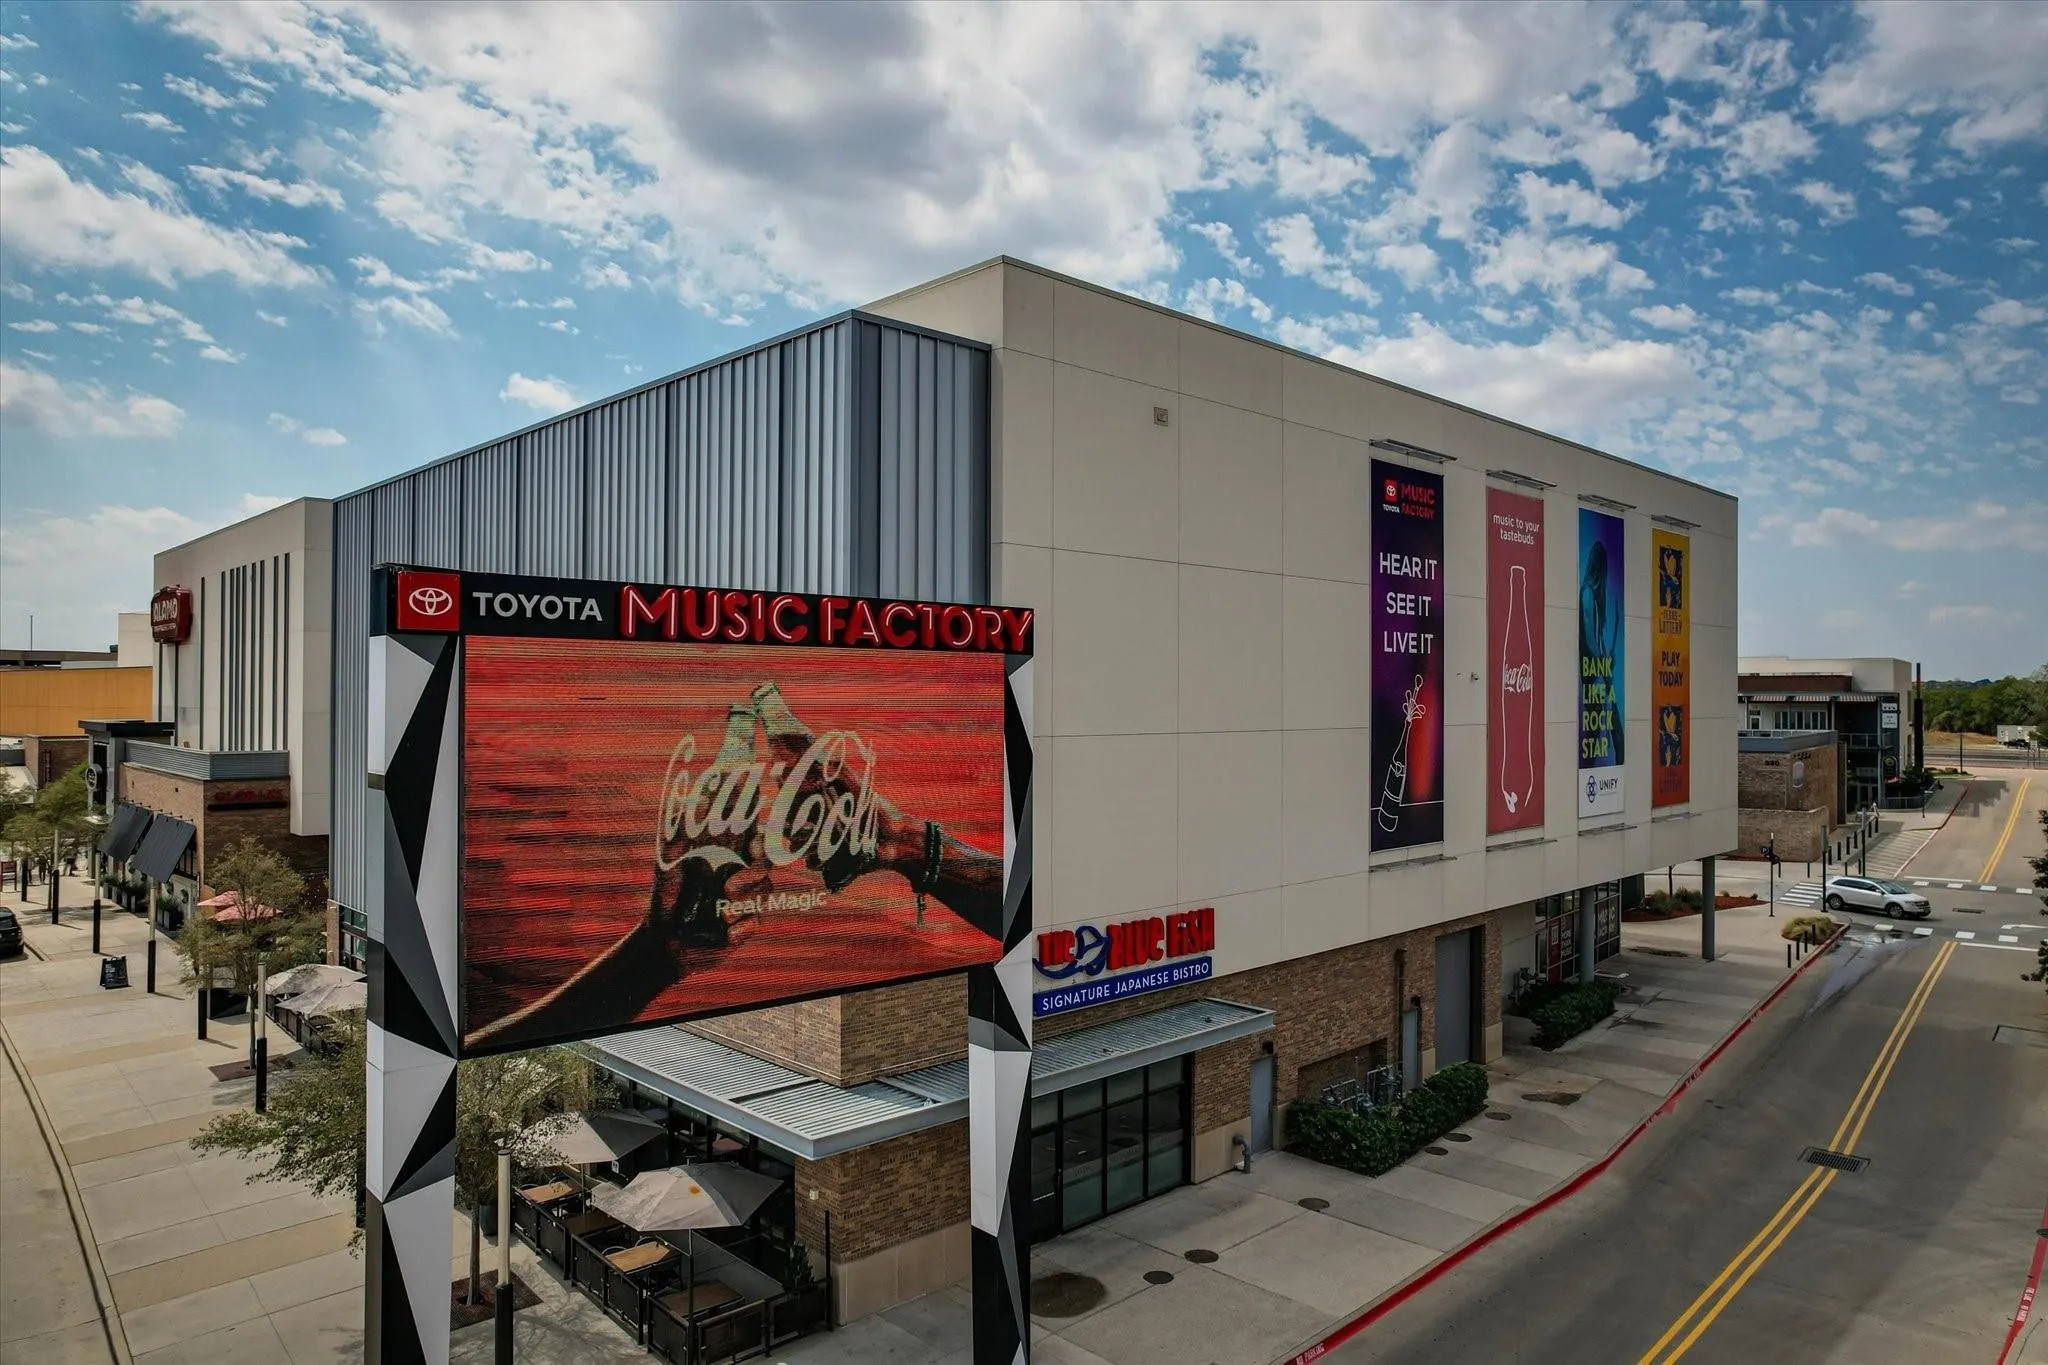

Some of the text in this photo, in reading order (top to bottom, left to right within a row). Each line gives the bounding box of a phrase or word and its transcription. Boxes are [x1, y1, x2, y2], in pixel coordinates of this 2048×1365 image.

[1401, 483, 1436, 505] MUSIC
[1382, 503, 1400, 513] TOYOTA
[1402, 502, 1435, 520] FACTORY
[1493, 514, 1540, 533] music to your
[1500, 528, 1534, 545] tastebuds
[1379, 552, 1438, 580] HEAR IT
[1386, 591, 1432, 617] SEE IT
[472, 584, 1033, 651] TOYOTA MUSIC FACTORY
[1384, 631, 1434, 655] LIVE IT
[1582, 656, 1613, 678] BANK
[1661, 650, 1680, 667] PLAY
[1658, 671, 1684, 688] TODAY
[1582, 683, 1616, 704] LIKE A
[1582, 710, 1614, 732] ROCK
[1581, 736, 1609, 759] STAR
[1599, 777, 1619, 791] UNIFY
[715, 889, 828, 918] Real Magic
[1042, 962, 1209, 1011] SIGNATURE JAPANESE BISTRO
